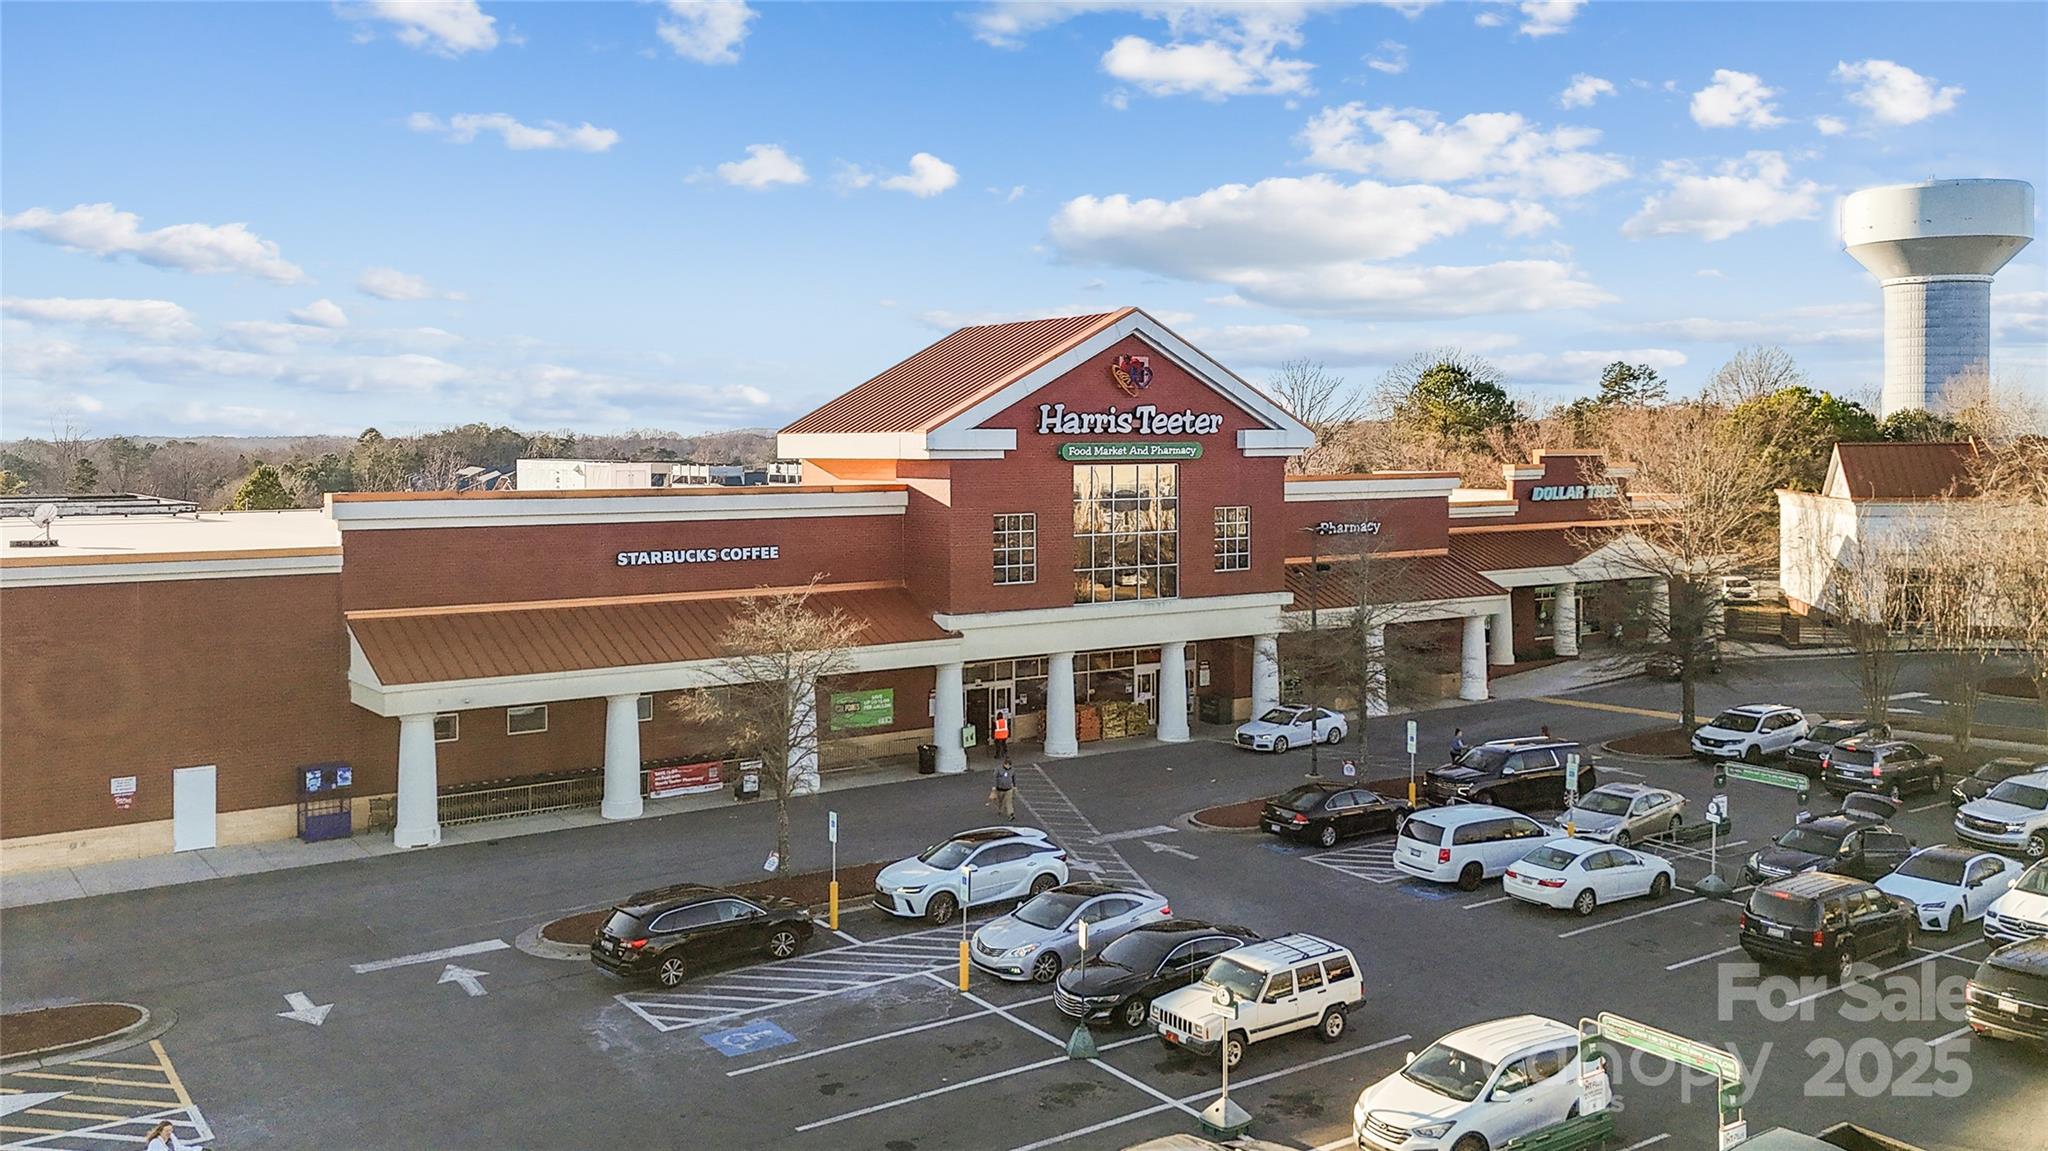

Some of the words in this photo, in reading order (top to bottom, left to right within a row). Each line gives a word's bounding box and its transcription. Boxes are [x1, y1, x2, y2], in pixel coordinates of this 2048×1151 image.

[1038, 403, 1132, 435] Harris
[1136, 404, 1223, 435] Teeter
[1068, 446, 1092, 456] Food
[1093, 446, 1127, 456] Market
[1129, 446, 1149, 456] And
[1150, 445, 1197, 457] Pharmacy
[1531, 485, 1584, 501] DOLLAR
[1319, 521, 1382, 535] Pharmacy
[616, 549, 717, 566] STARBUCKS
[720, 546, 779, 561] COFFEE
